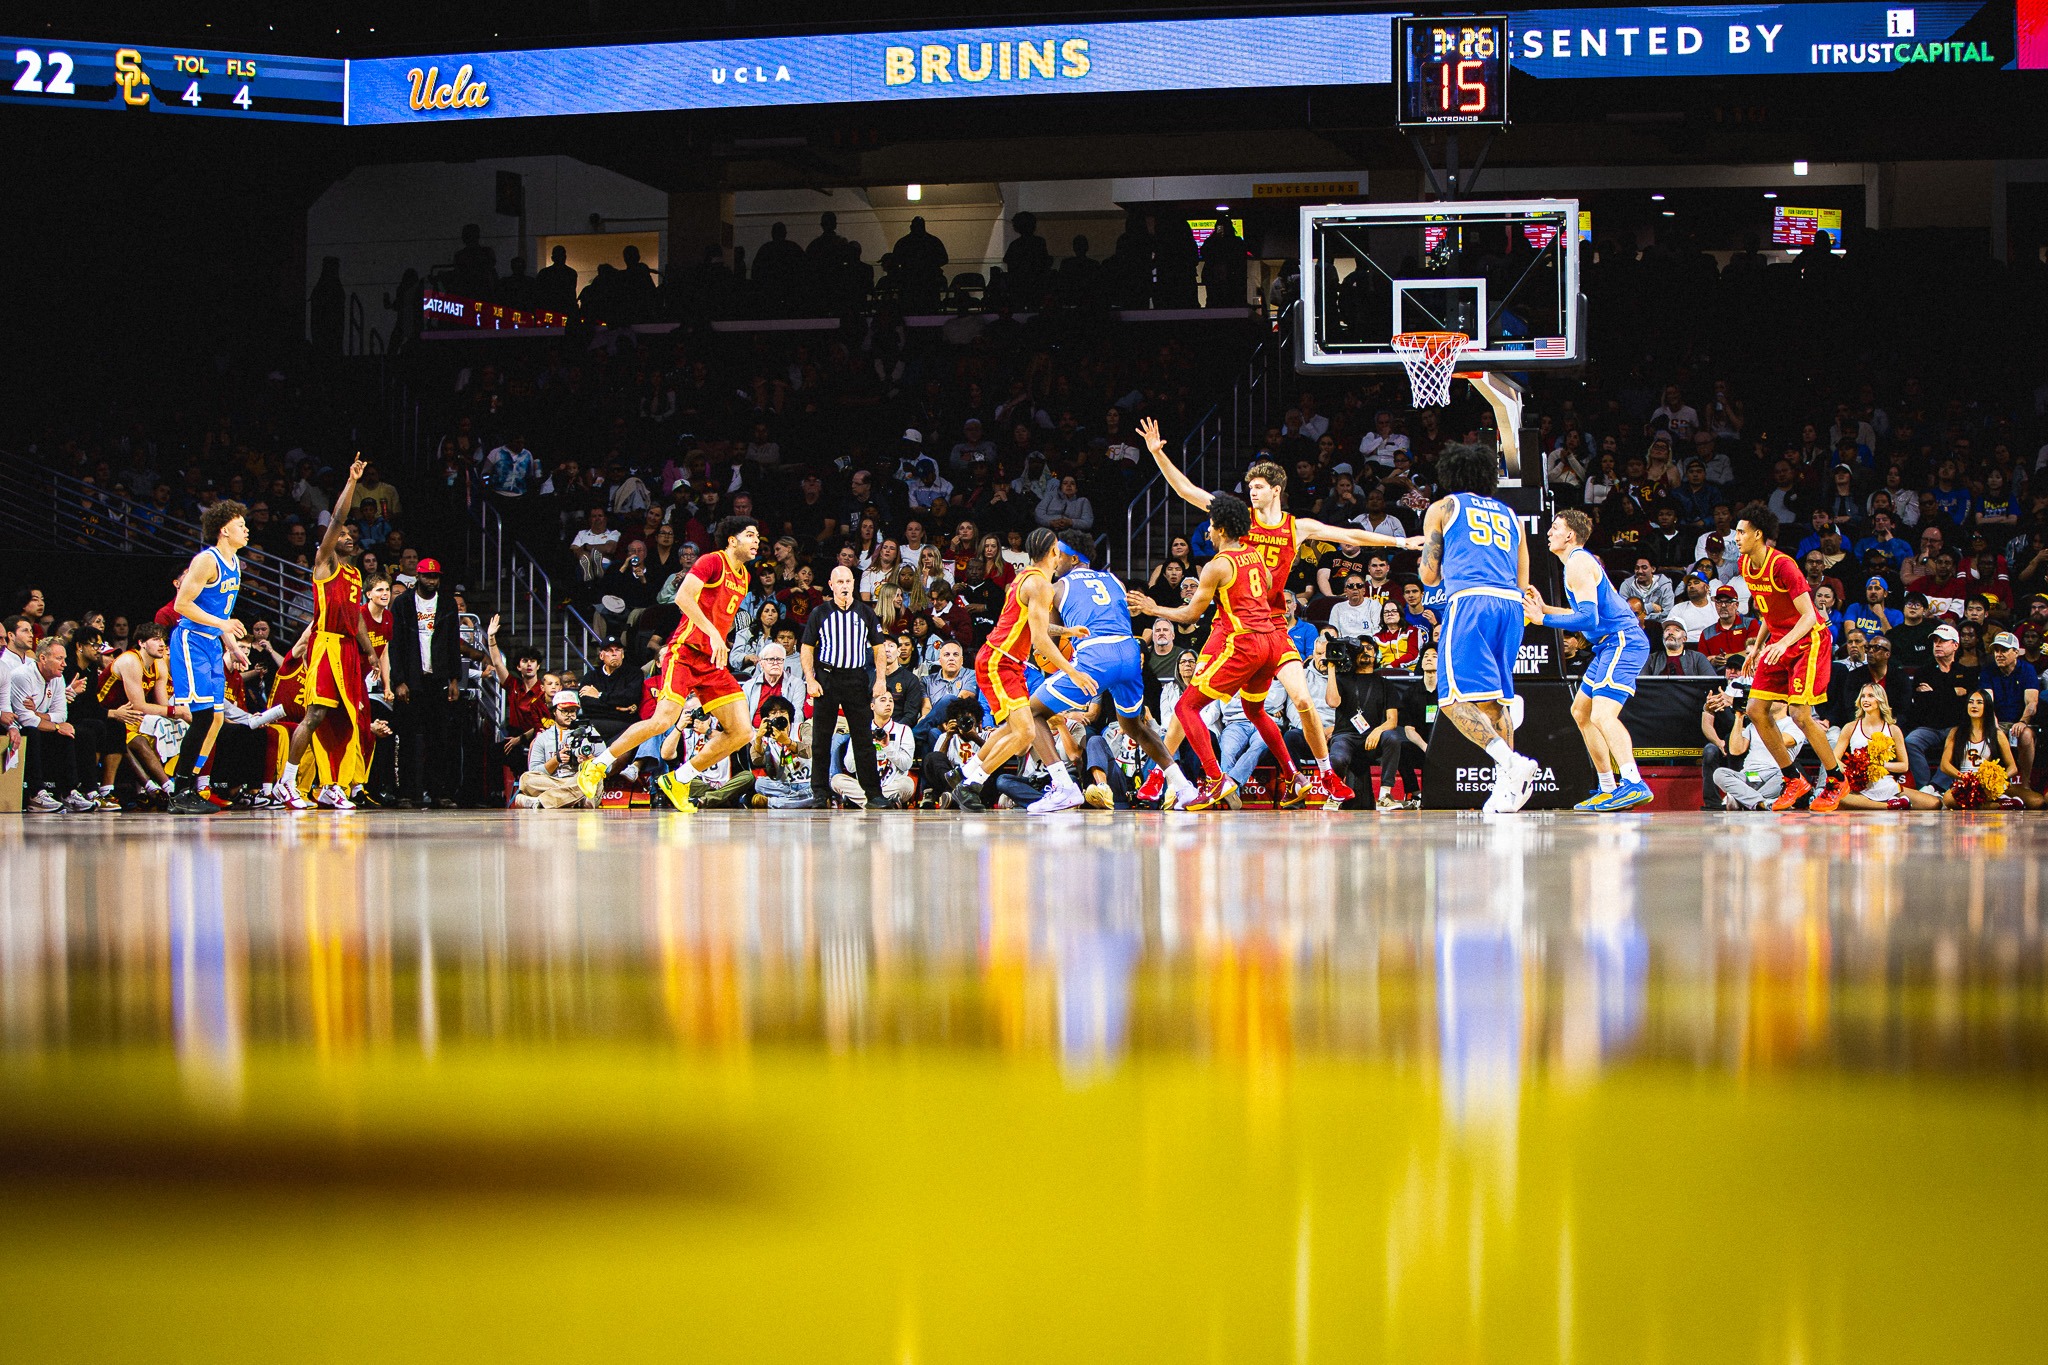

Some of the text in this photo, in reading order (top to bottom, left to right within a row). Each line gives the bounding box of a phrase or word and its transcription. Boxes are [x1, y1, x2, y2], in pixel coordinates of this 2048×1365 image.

[1728, 23, 1784, 55] BY
[884, 37, 1092, 87] BRUINS
[1811, 41, 1995, 65] ITRUSTCAPITAL
[12, 49, 75, 94] 22
[173, 55, 257, 77] TOL FLS
[711, 65, 792, 85] UCLA
[181, 81, 252, 110] 4 4
[406, 63, 490, 112] Ucla
[1441, 60, 1487, 113] 15
[1426, 115, 1479, 123] DAKTRONICS
[1257, 183, 1355, 196] CONCESSIONS
[1470, 497, 1501, 512] CLARK
[1248, 532, 1289, 546] TROJANS
[1465, 507, 1511, 554] 55
[1332, 558, 1363, 573] USC
[1083, 579, 1112, 606] 3
[1248, 568, 1263, 598] 8
[223, 593, 235, 616] 0
[349, 585, 358, 604] 2
[726, 594, 739, 615] 6
[1755, 594, 1769, 613] 0
[1856, 617, 1881, 631] UCL
[1516, 644, 1549, 660] SCLE
